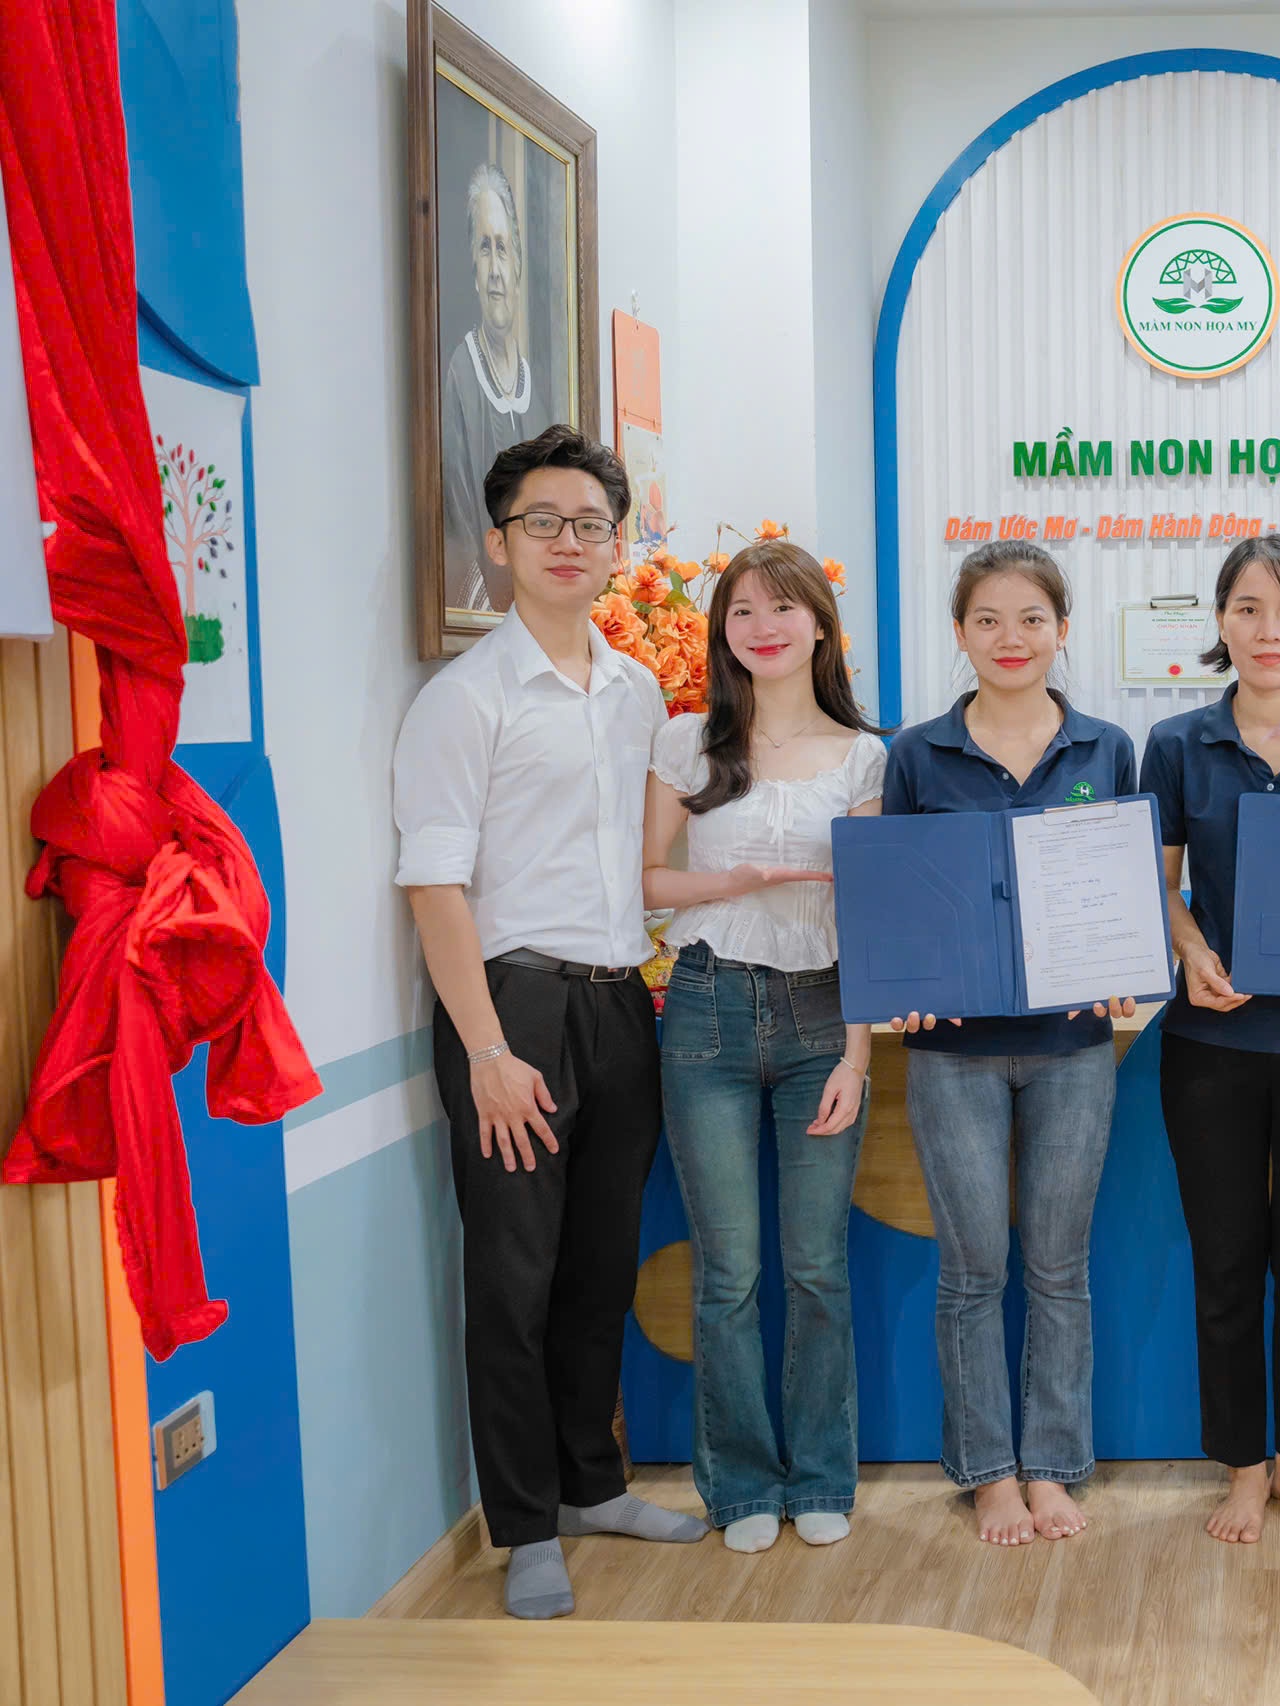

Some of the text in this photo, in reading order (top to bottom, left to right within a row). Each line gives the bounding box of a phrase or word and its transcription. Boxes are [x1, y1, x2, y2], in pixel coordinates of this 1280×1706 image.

[1175, 320, 1202, 332] NON
[1206, 320, 1234, 334] HỌA
[1237, 320, 1257, 332] MY
[1013, 426, 1113, 478] MẦM
[1130, 438, 1213, 477] NON
[944, 516, 993, 541] Dám
[998, 514, 1039, 541] Ước
[1043, 515, 1078, 540] Mơ
[1096, 514, 1144, 540] Dám
[1149, 513, 1203, 539] Hành
[1207, 512, 1262, 543] Động
